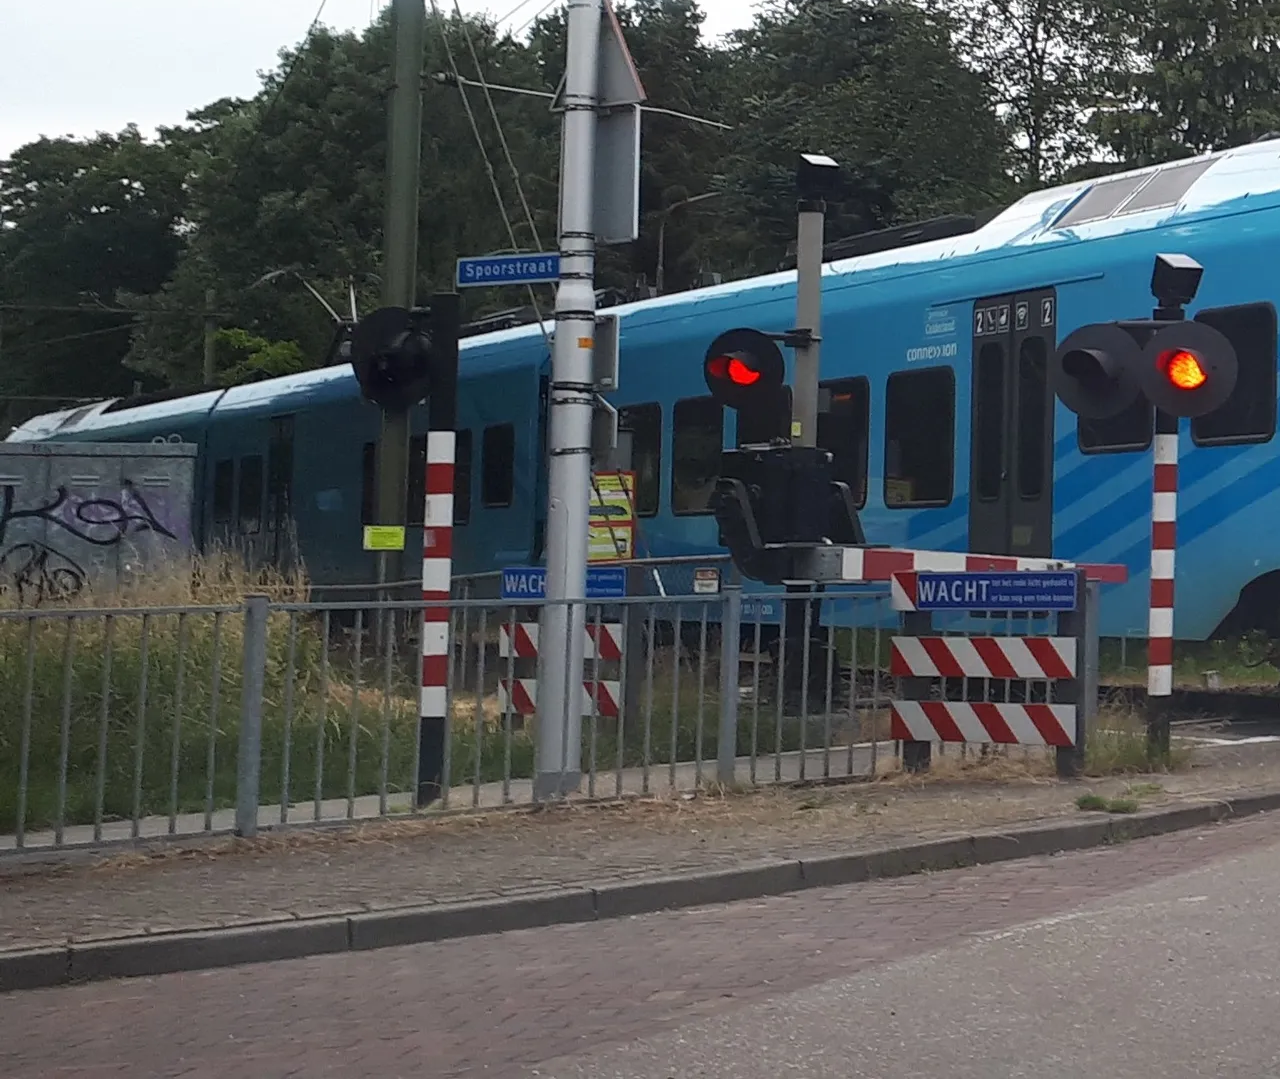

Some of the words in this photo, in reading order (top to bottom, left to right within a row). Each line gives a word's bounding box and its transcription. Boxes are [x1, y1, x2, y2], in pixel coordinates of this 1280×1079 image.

[465, 259, 553, 280] Spoorstraat
[976, 312, 983, 333] 2
[1044, 301, 1051, 323] 2
[505, 574, 547, 593] WACH
[919, 581, 990, 602] WACHT
